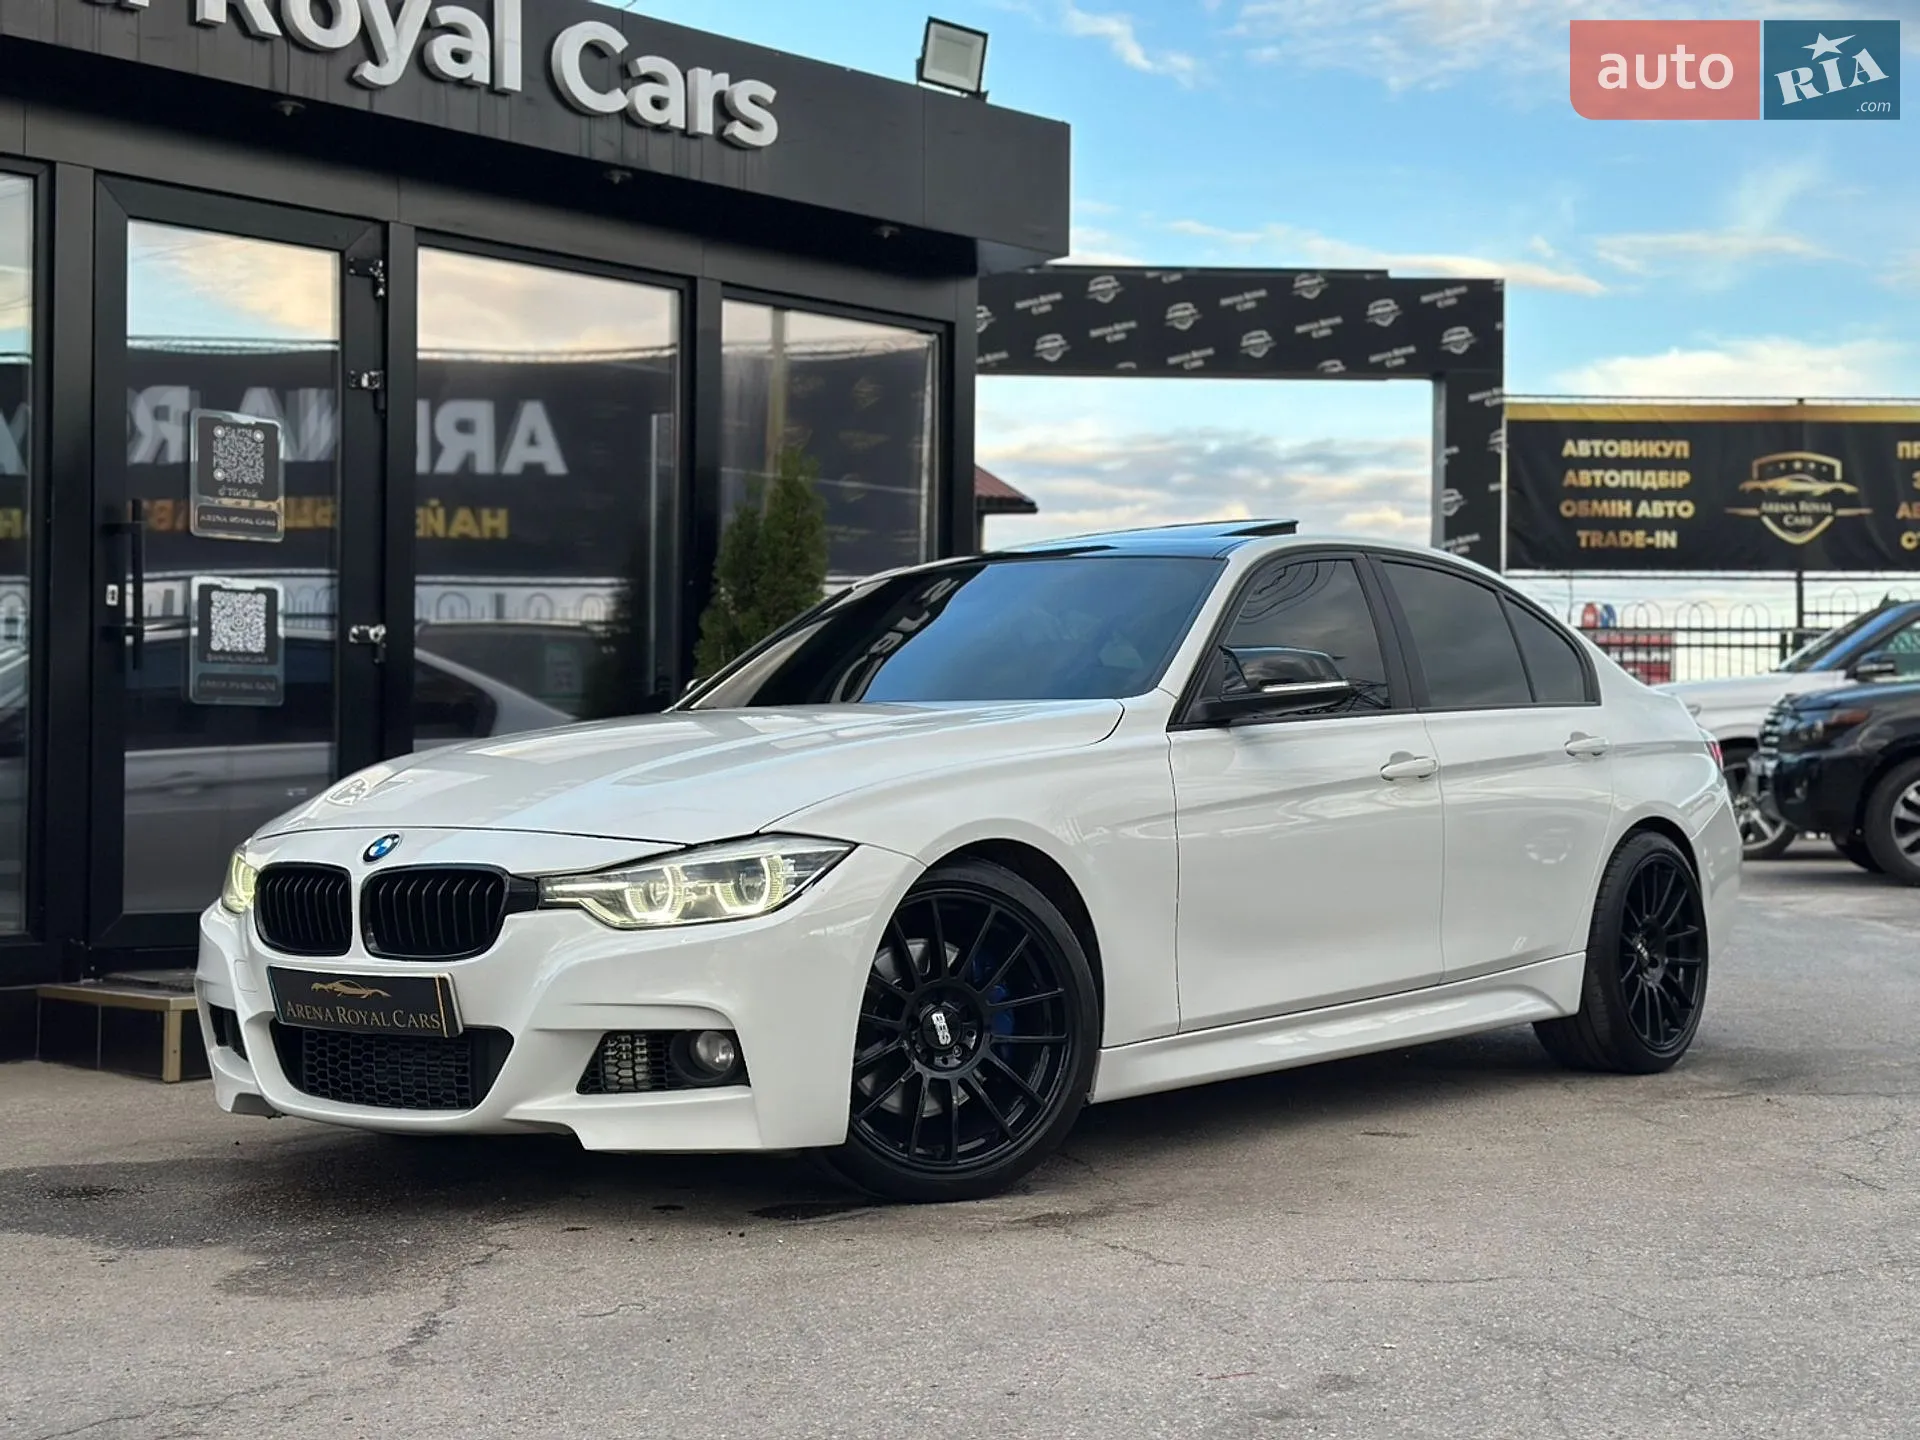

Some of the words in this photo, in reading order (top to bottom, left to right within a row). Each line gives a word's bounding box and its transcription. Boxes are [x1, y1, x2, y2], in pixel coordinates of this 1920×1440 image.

[550, 20, 778, 148] Cars
[1561, 438, 1690, 458] АВТОВИКУП
[1562, 468, 1691, 491] АВТОПІДБІР
[1559, 499, 1633, 518] ОБМІН
[1636, 499, 1695, 518] АВТО
[1576, 530, 1678, 548] TRADE-IN
[286, 1000, 335, 1023] ARENA
[336, 1005, 391, 1027] ROYAL
[393, 1009, 441, 1030] CARS
